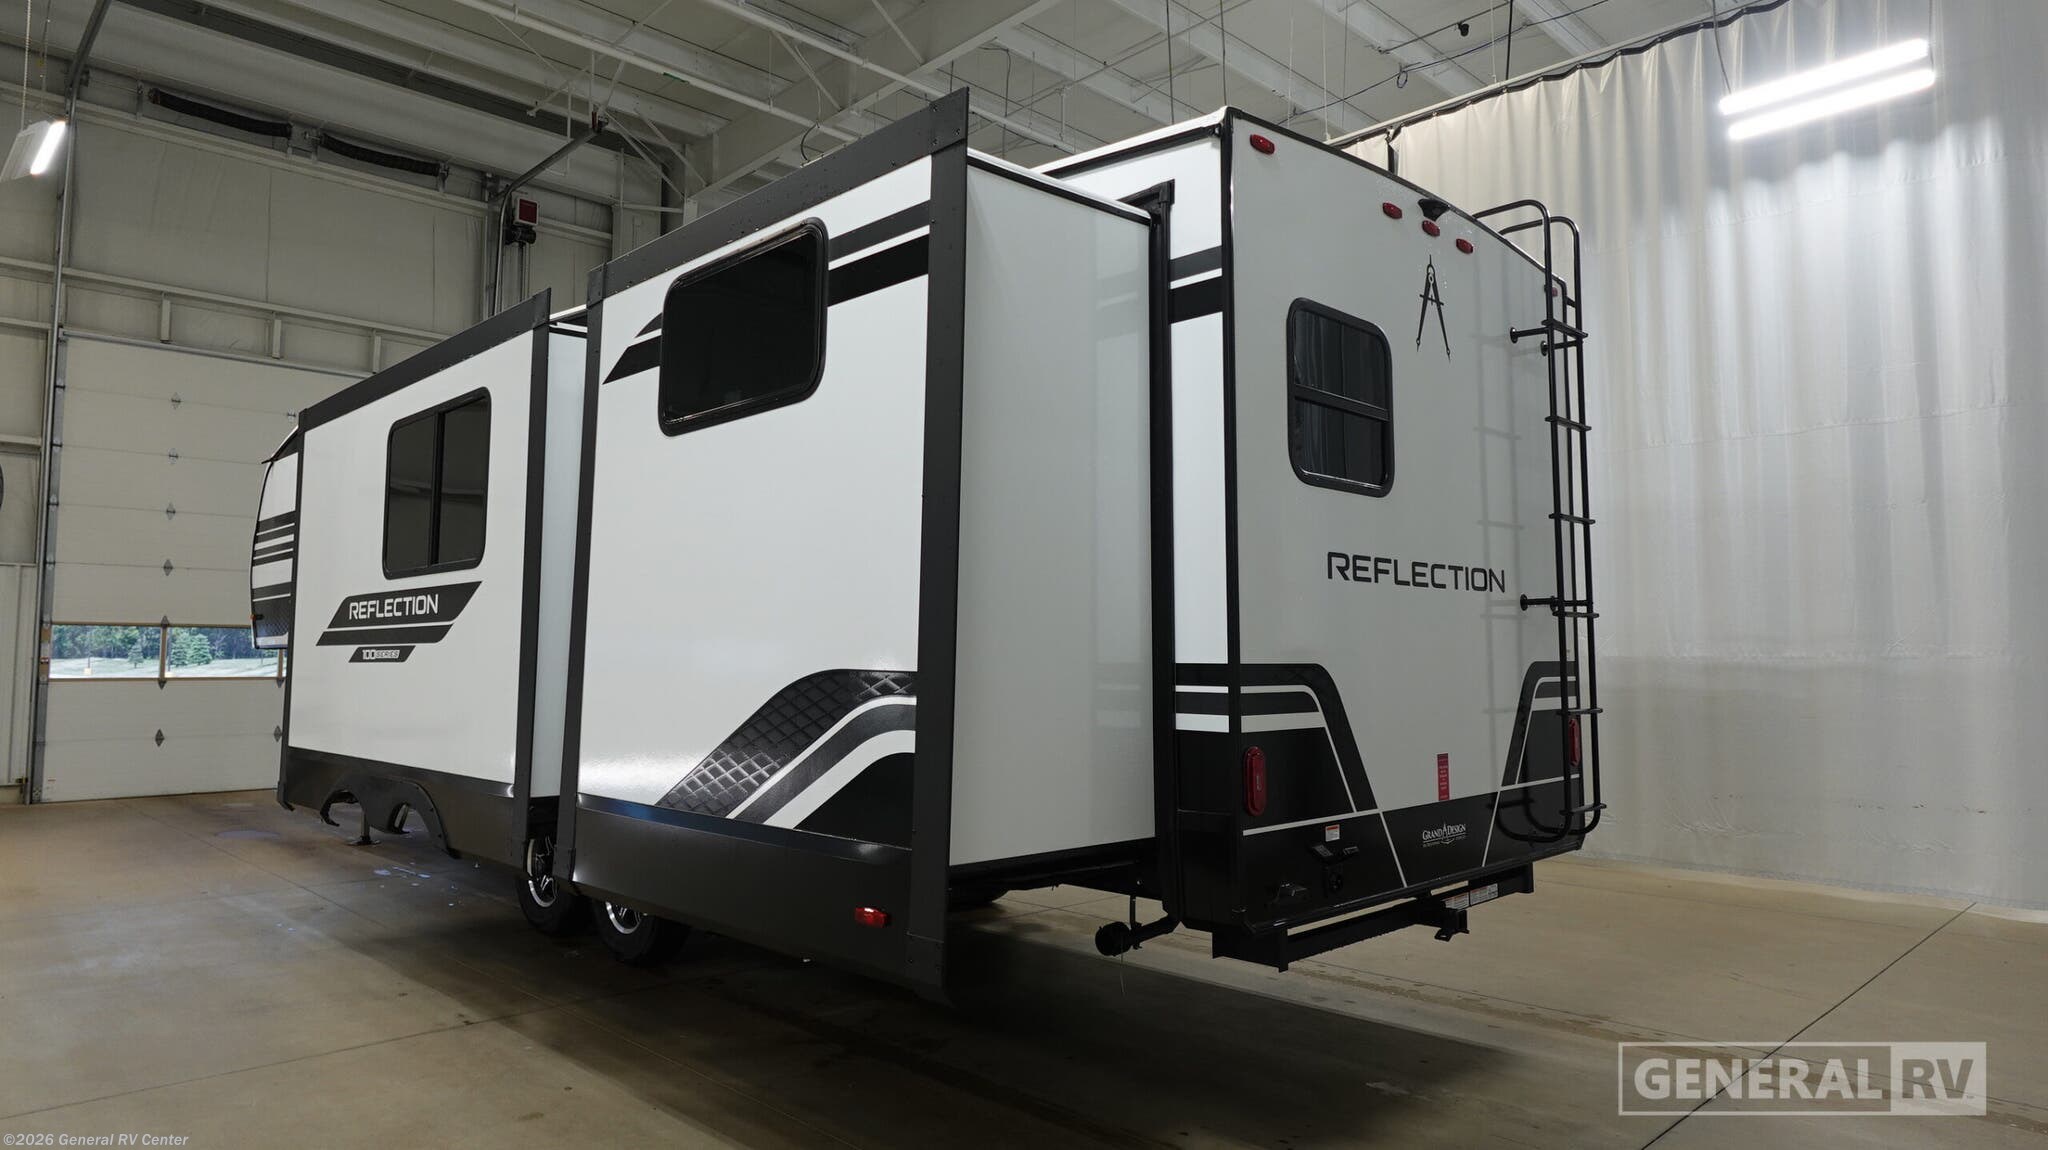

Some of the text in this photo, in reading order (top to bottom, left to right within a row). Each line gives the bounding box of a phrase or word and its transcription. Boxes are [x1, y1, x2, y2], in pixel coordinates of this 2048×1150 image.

[1327, 551, 1506, 593] REFLECTION
[348, 594, 439, 620] REFLECTION
[1422, 828, 1443, 840] GRAND
[1447, 823, 1466, 835] DESIGN
